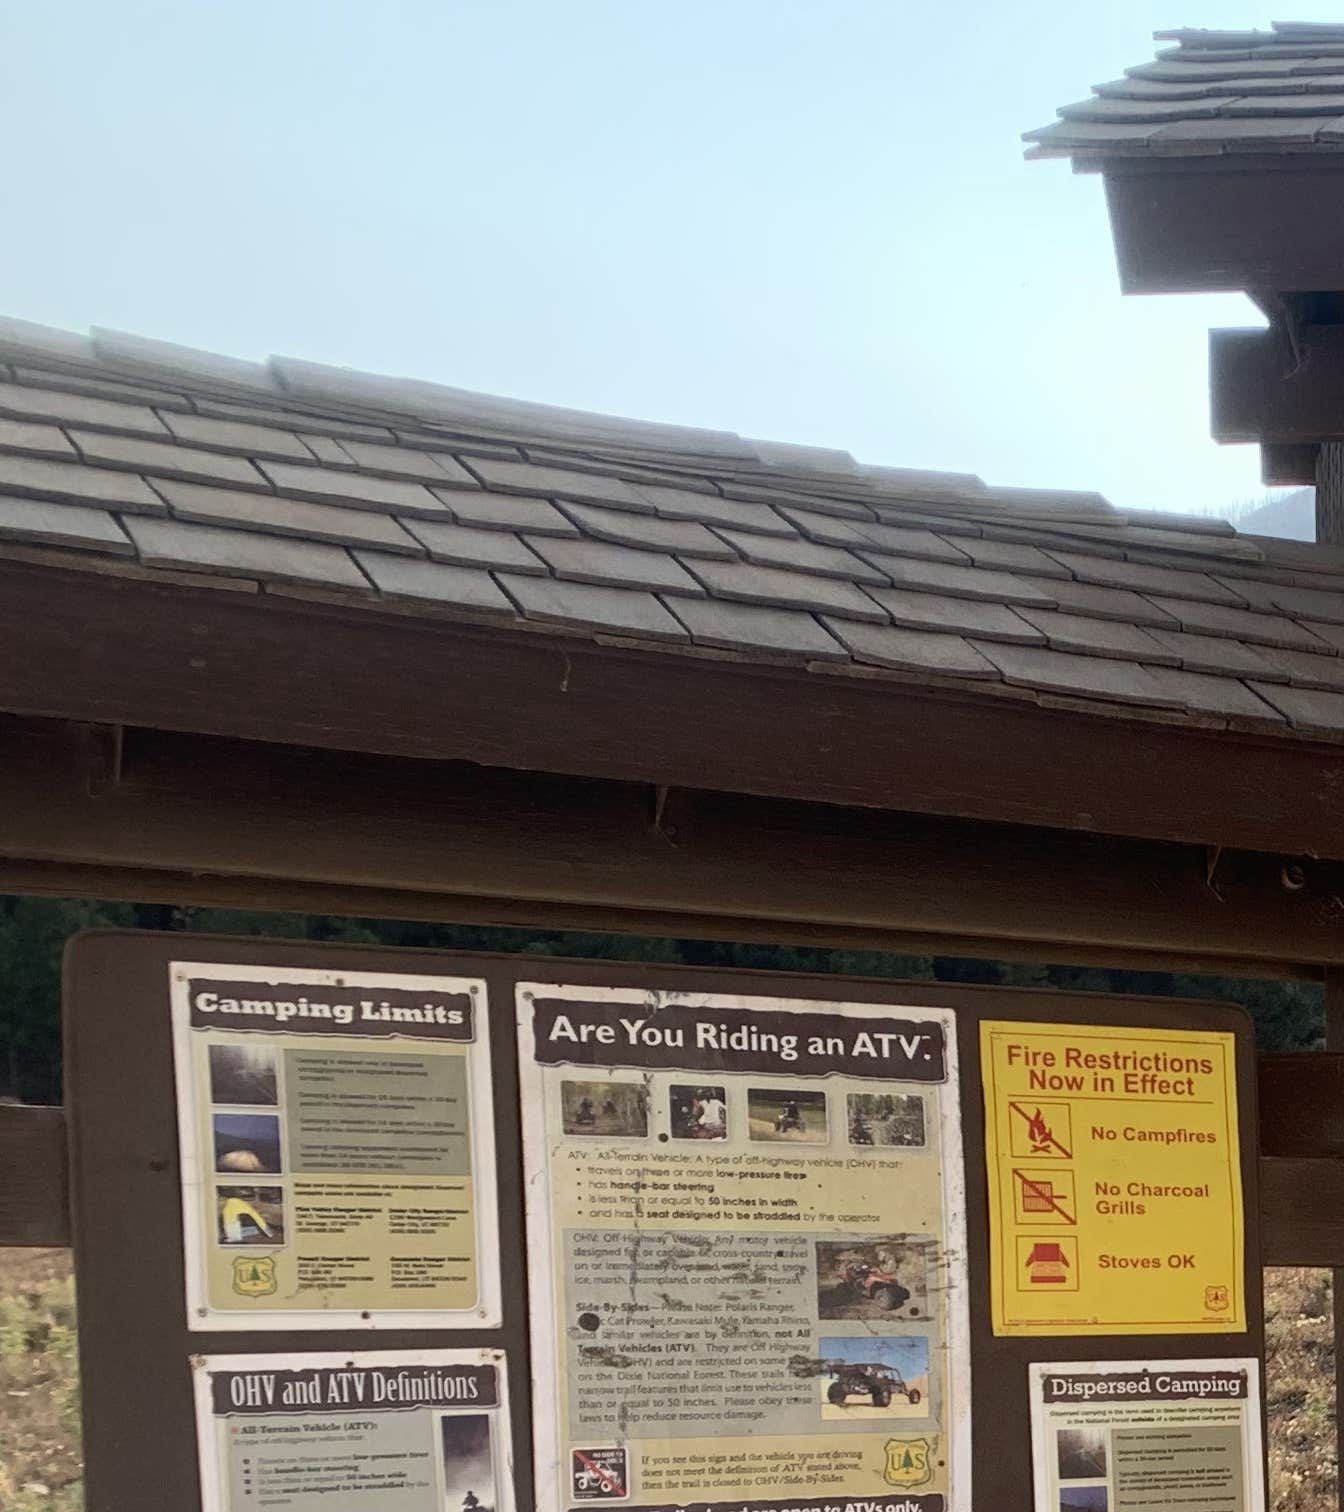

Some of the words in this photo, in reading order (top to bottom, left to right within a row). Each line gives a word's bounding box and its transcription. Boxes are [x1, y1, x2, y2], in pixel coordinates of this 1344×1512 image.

[195, 992, 354, 1024] Camping
[360, 1001, 463, 1025] Limits
[548, 1015, 615, 1043] Are
[619, 1018, 684, 1048] You
[696, 1022, 798, 1061] Riding
[807, 1036, 844, 1056] an
[1007, 1045, 1056, 1067] Fire
[1065, 1047, 1213, 1074] Restrictions
[1029, 1069, 1084, 1092] Now
[1093, 1072, 1114, 1093] in
[1124, 1073, 1195, 1096] Effect
[1091, 1126, 1117, 1142] No
[1123, 1128, 1217, 1145] Campfires
[1095, 1182, 1121, 1197] No
[1127, 1183, 1209, 1198] Charcoal
[1096, 1200, 1146, 1216] Grills
[1098, 1254, 1162, 1269] Stoves
[1168, 1254, 1196, 1269] OK
[725, 1303, 757, 1312] Polaris
[230, 1374, 275, 1407] OHV
[282, 1373, 322, 1406] and
[327, 1372, 369, 1404] ATV
[373, 1370, 479, 1402] Definitions
[1051, 1377, 1151, 1399] Dispersed
[1156, 1376, 1241, 1397] Camping
